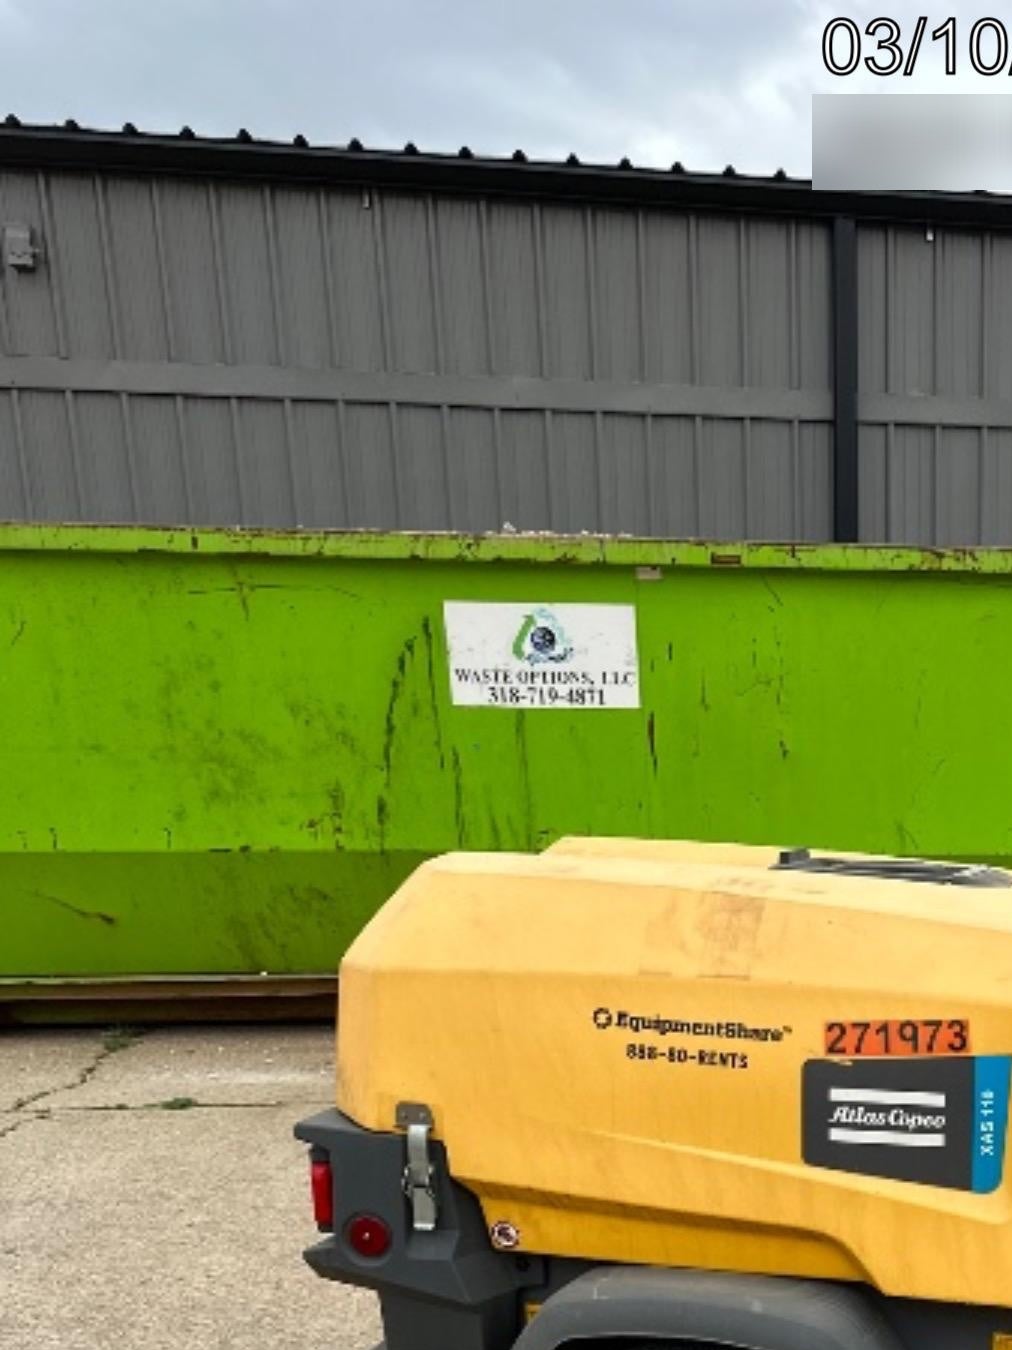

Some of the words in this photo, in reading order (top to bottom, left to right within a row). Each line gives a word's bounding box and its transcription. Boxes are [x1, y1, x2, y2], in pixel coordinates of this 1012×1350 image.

[454, 668, 511, 685] WASTE
[516, 670, 595, 686] OPTIONS,
[601, 671, 636, 686] LLC
[488, 686, 606, 706] 318-719-4871
[826, 1020, 968, 1054] 271973
[828, 1106, 886, 1126] Atlas
[887, 1108, 946, 1131] Copco
[979, 1120, 994, 1157] XAS
